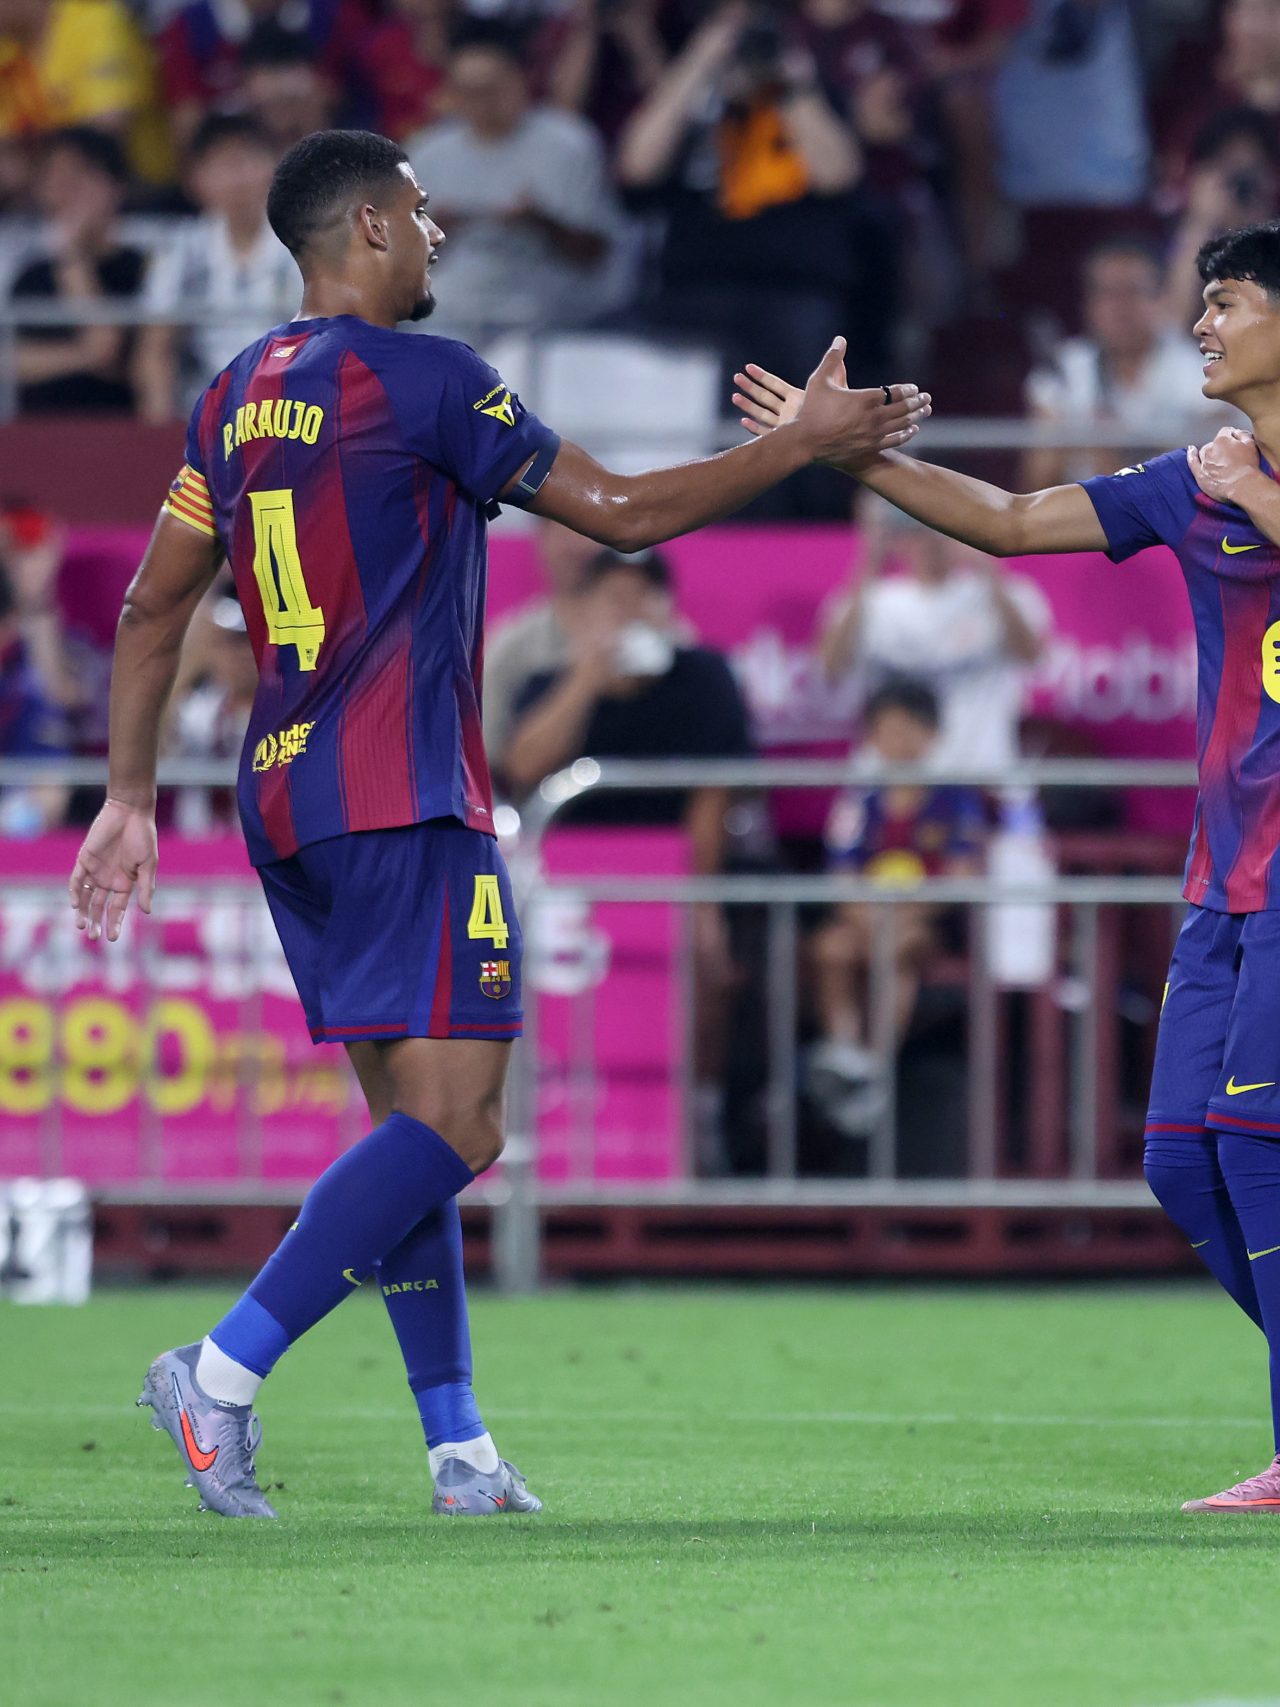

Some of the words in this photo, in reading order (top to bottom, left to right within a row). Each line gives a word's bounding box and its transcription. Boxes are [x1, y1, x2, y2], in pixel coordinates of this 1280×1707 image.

[235, 399, 324, 447] ARAUJO
[247, 489, 326, 671] 4
[467, 875, 509, 949] 4
